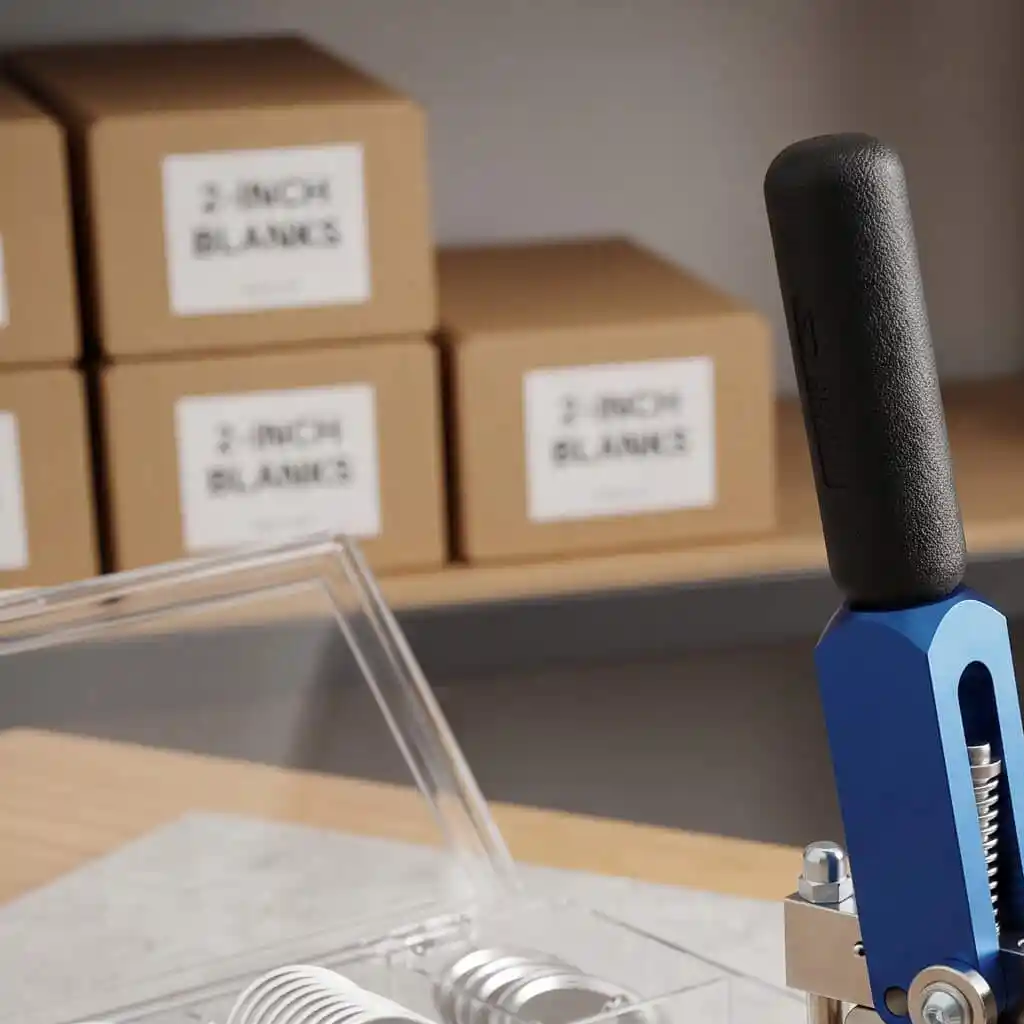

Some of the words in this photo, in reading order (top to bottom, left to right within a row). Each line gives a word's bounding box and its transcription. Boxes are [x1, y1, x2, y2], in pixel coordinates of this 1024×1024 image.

[192, 222, 342, 259] BLANKS
[552, 428, 687, 468] BLANKS
[206, 458, 353, 497] BLANKS
